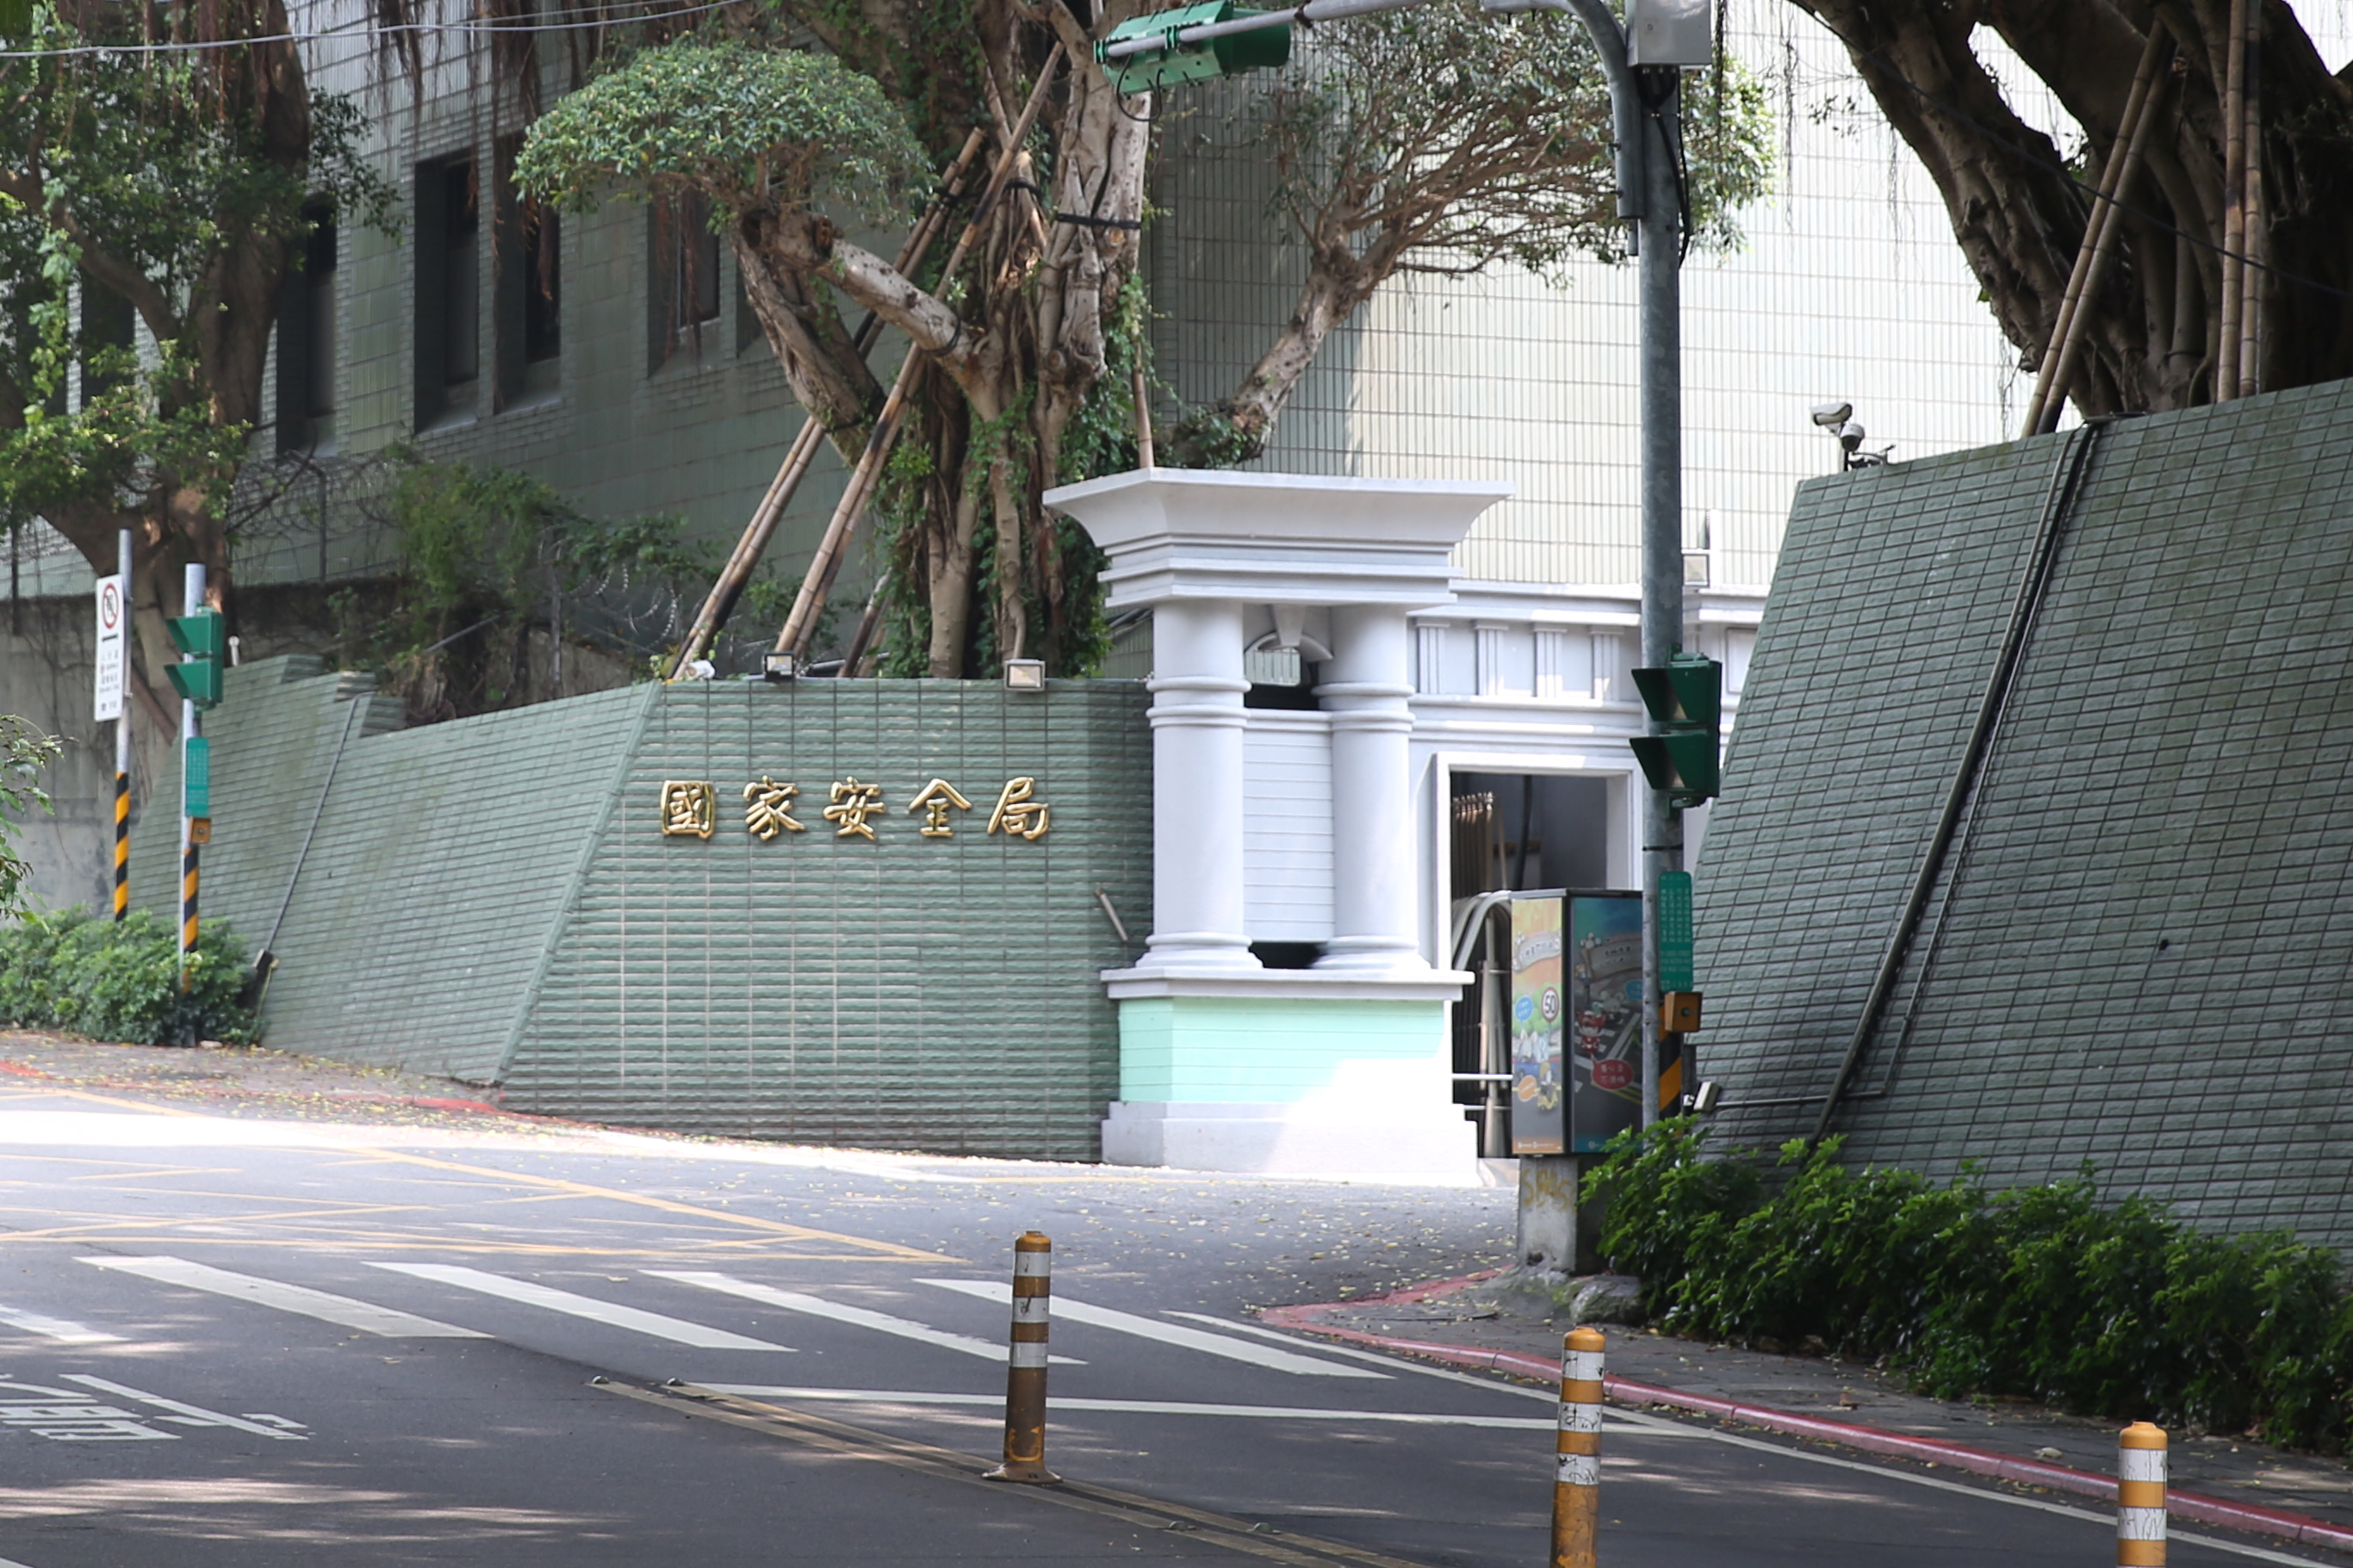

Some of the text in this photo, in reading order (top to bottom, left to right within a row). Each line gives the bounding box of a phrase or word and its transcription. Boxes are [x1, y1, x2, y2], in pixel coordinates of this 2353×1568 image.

[660, 775, 1051, 841] 國家安全局
[1544, 995, 1557, 1014] 50
